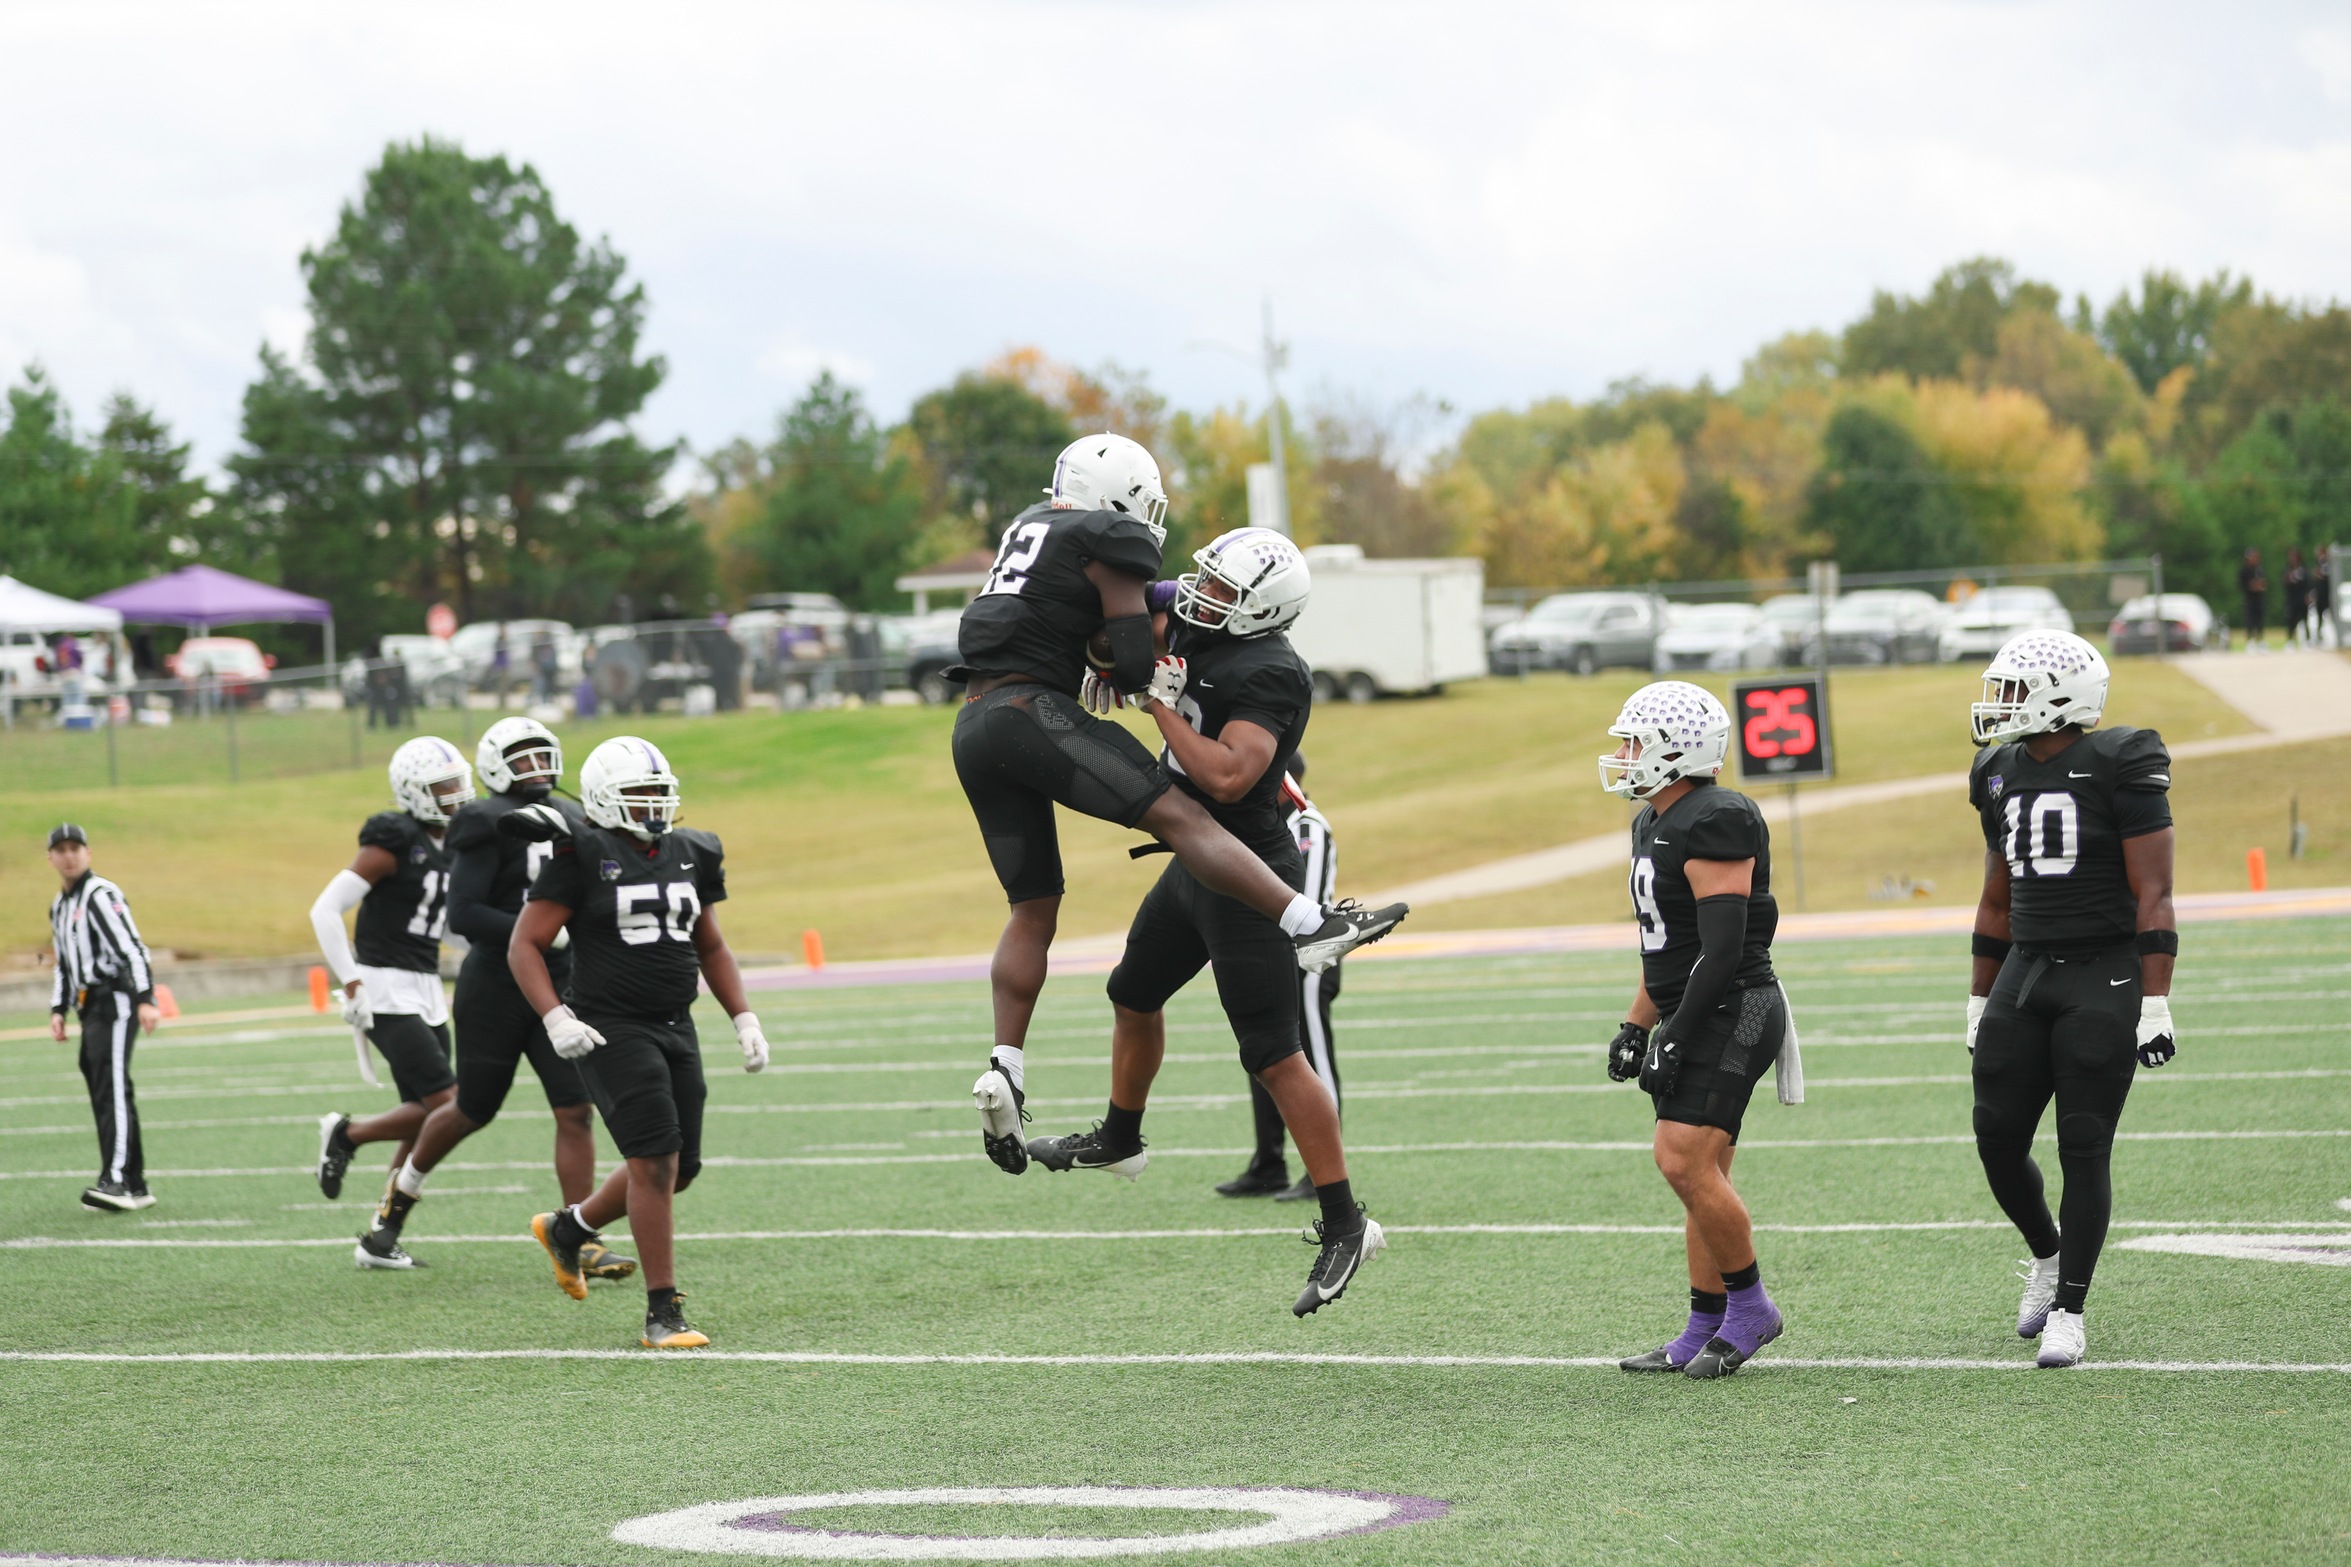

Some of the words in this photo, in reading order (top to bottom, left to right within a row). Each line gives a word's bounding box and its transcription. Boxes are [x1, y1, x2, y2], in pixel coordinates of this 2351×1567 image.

[978, 519, 1051, 596] 12
[1743, 686, 1816, 758] 25
[2003, 790, 2079, 878] 10
[616, 881, 701, 946] 50
